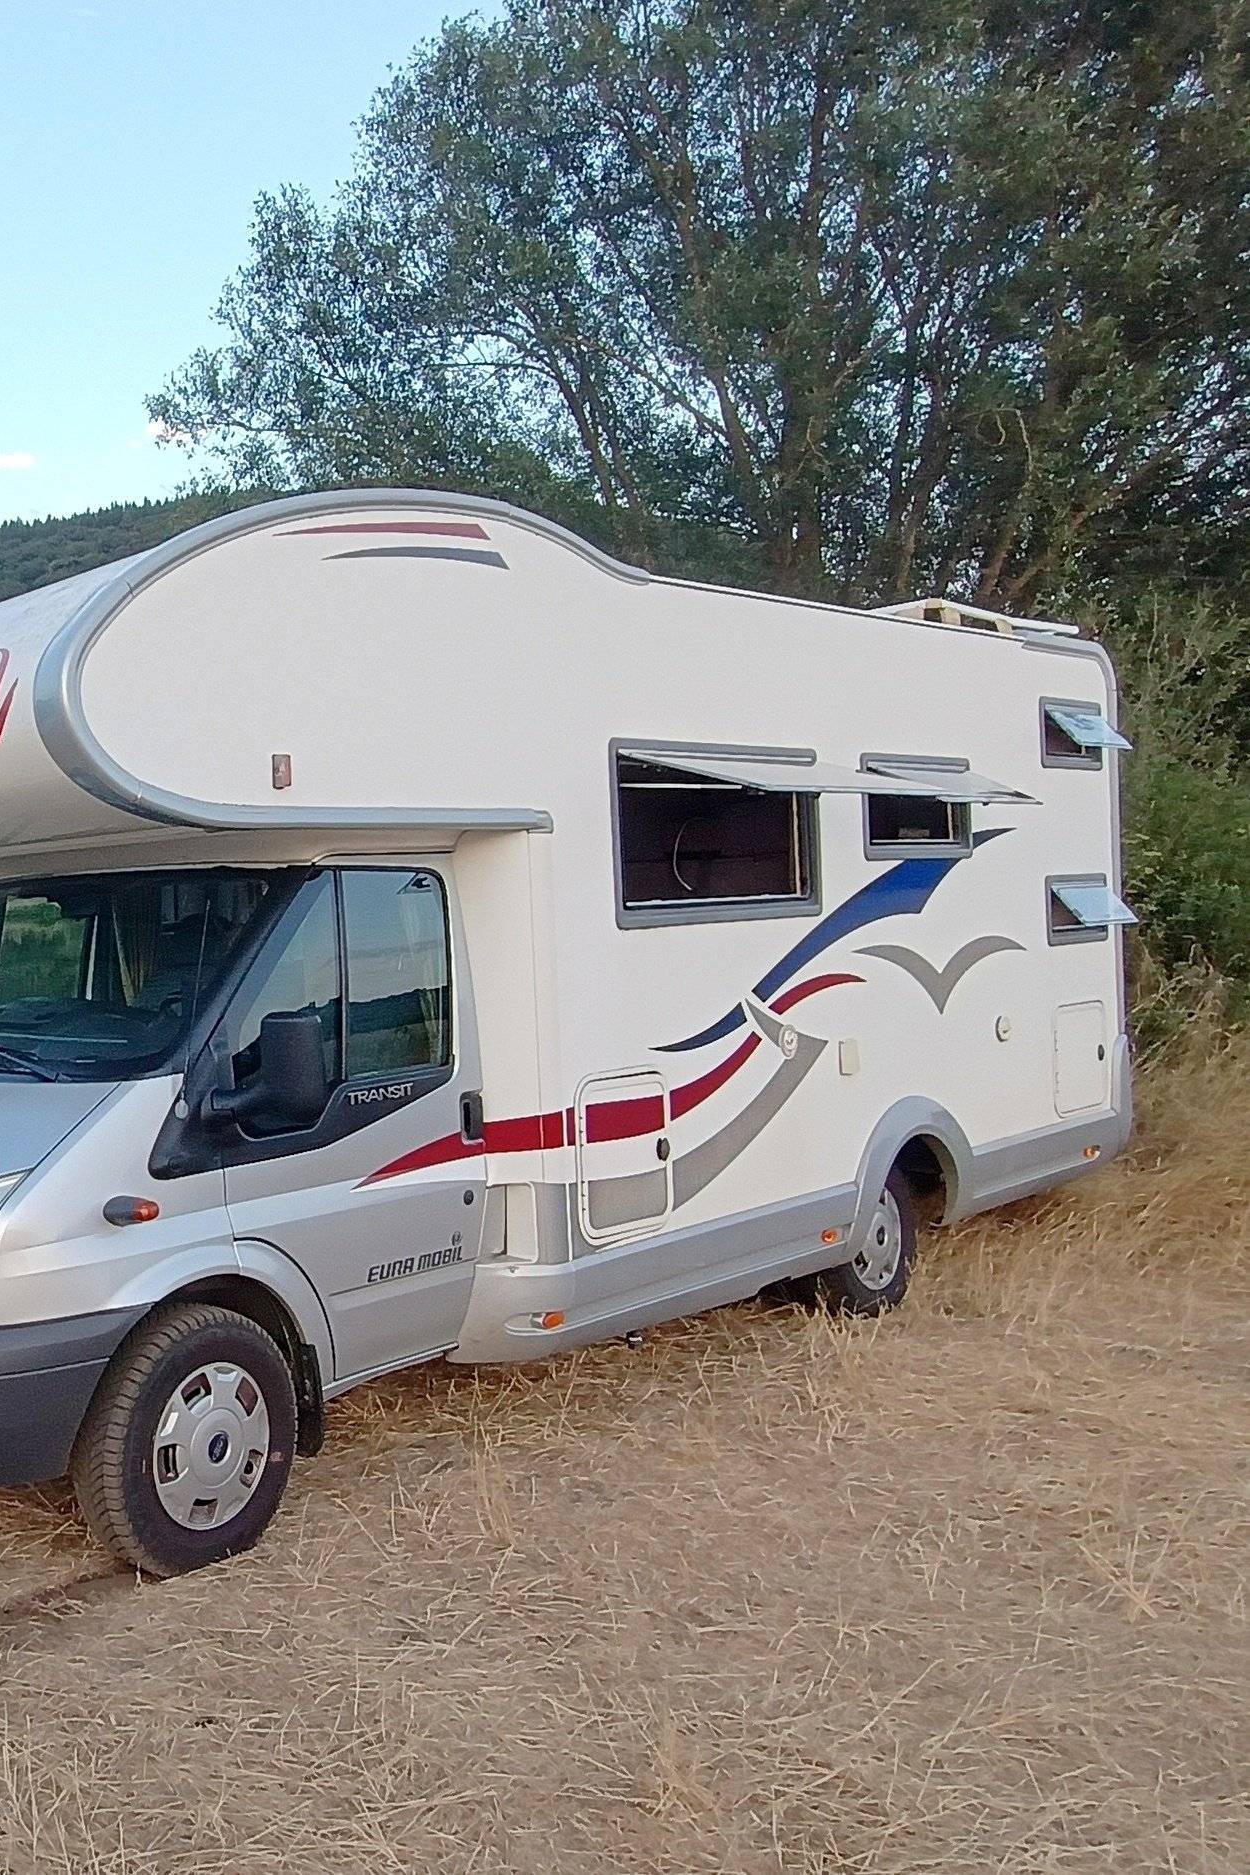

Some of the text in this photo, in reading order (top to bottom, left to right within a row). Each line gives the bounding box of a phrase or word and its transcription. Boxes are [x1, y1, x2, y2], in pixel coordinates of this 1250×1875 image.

[348, 1083, 414, 1105] TRANSIT
[367, 1246, 463, 1283] EURA MOBIL
